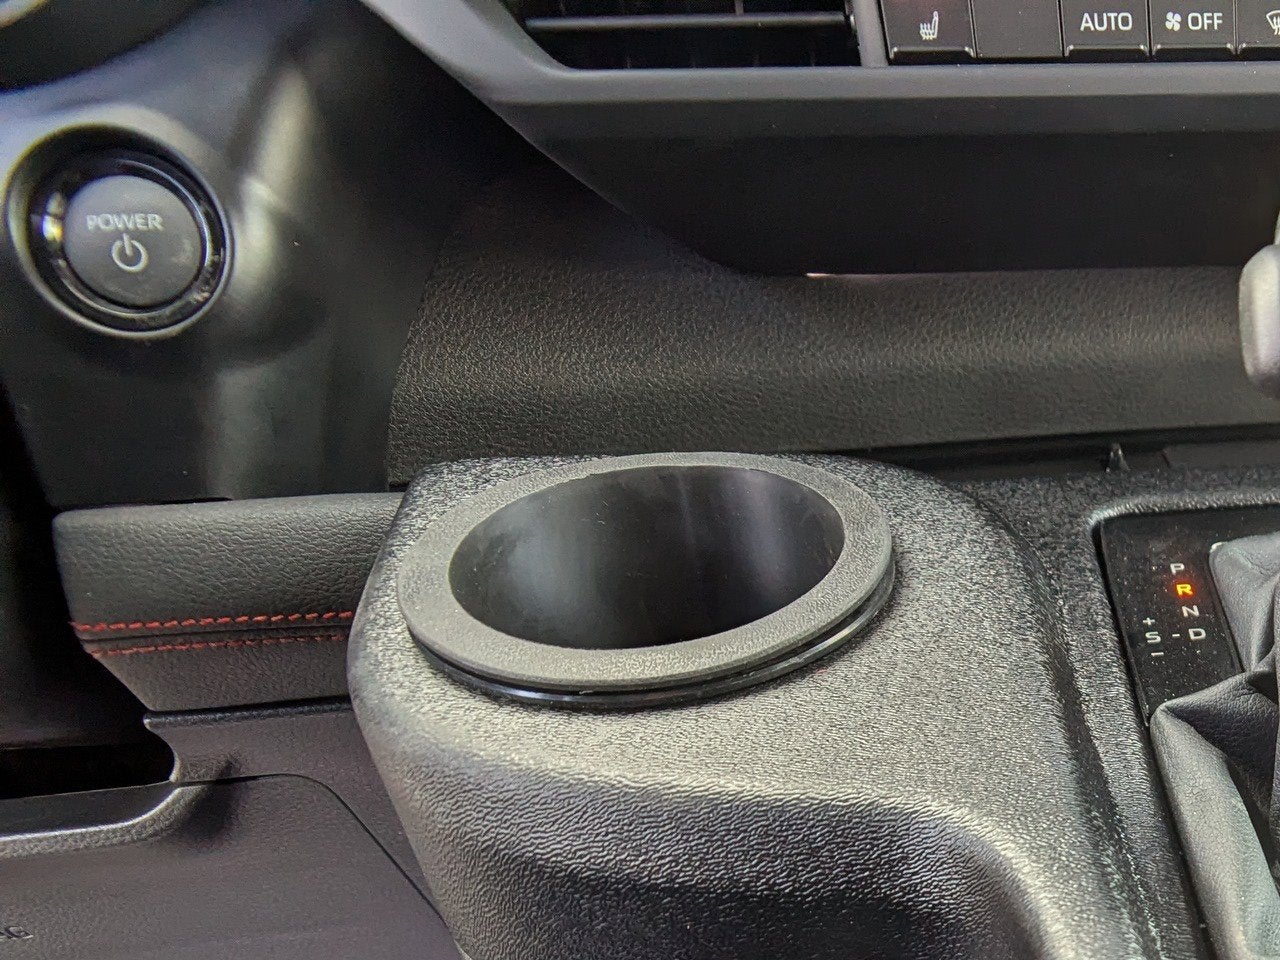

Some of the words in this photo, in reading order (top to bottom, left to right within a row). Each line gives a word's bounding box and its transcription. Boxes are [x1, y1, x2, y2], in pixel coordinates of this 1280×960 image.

[1080, 12, 1133, 31] AUTO
[1187, 12, 1223, 31] OFF
[86, 213, 165, 232] POWER
[1170, 563, 1185, 575] P
[1176, 583, 1194, 596] R
[1181, 605, 1200, 617] N
